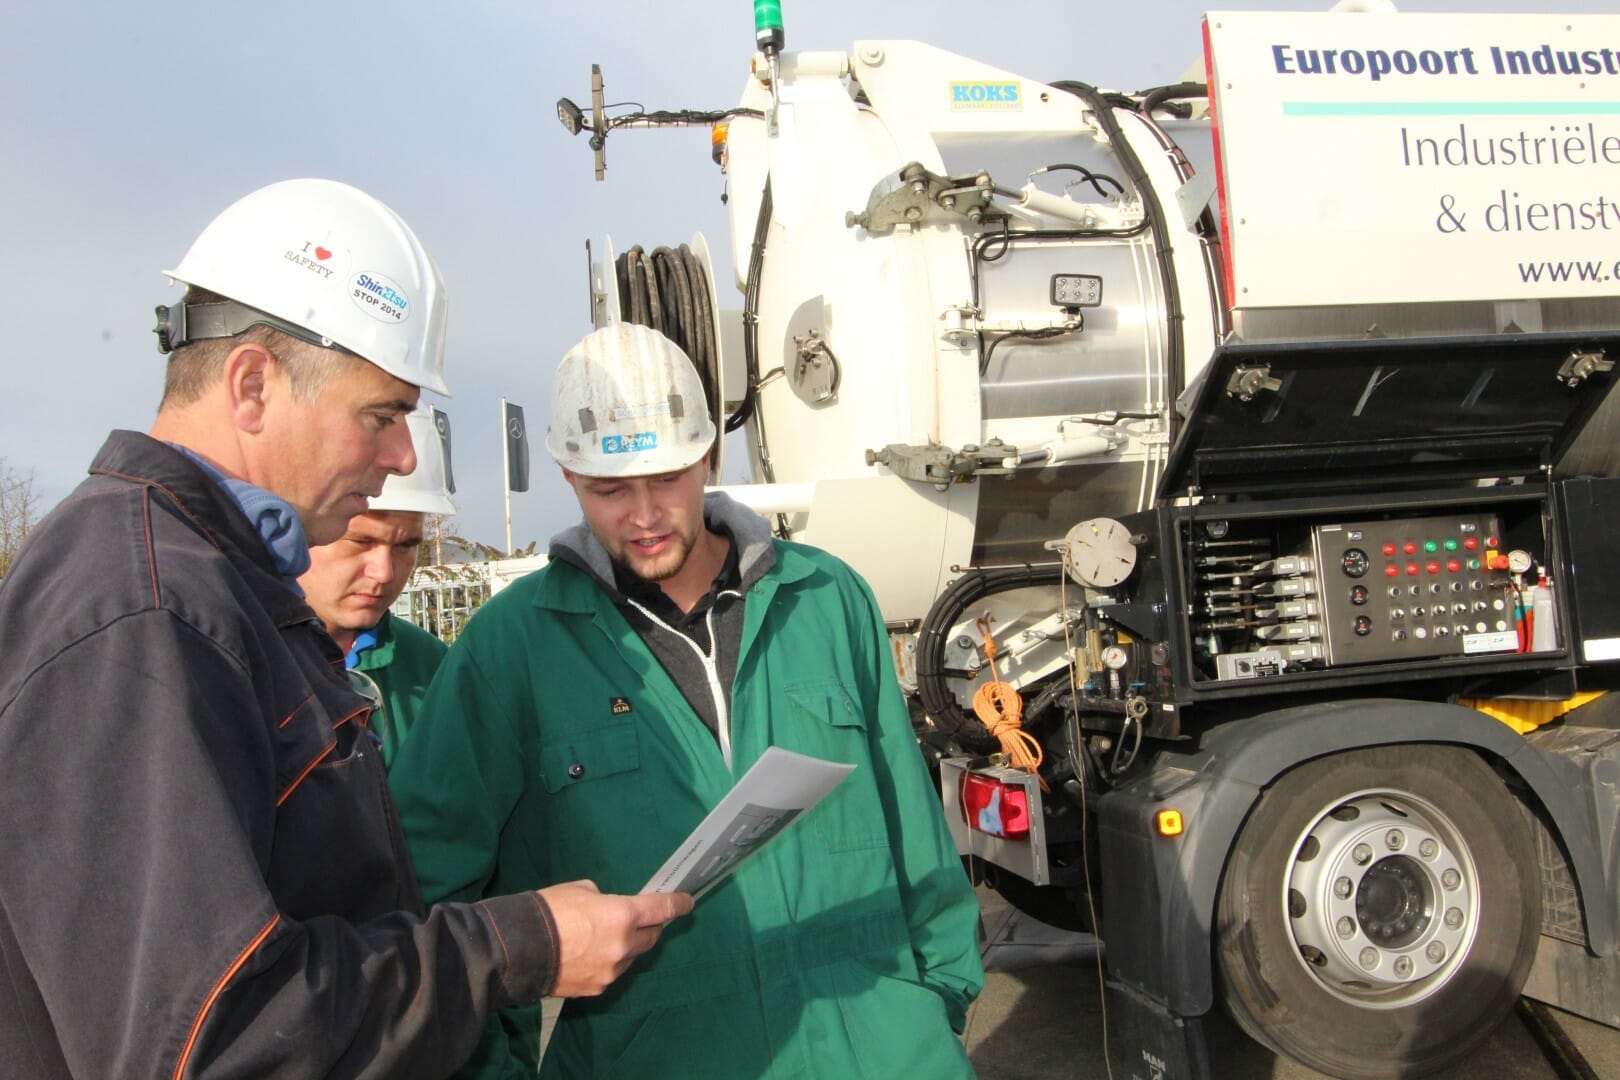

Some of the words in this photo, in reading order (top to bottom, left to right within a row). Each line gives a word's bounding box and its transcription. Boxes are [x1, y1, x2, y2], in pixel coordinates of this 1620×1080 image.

[1271, 44, 1479, 81] Europoort
[1489, 44, 1620, 75] Indust
[952, 85, 1019, 101] KOKS
[1400, 122, 1620, 166] Industriële
[1436, 194, 1467, 233] &
[300, 240, 312, 253] I
[284, 250, 334, 279] SAFETY
[353, 289, 379, 306] STOP
[380, 302, 402, 320] 2014
[1142, 1049, 1167, 1072] MAN
